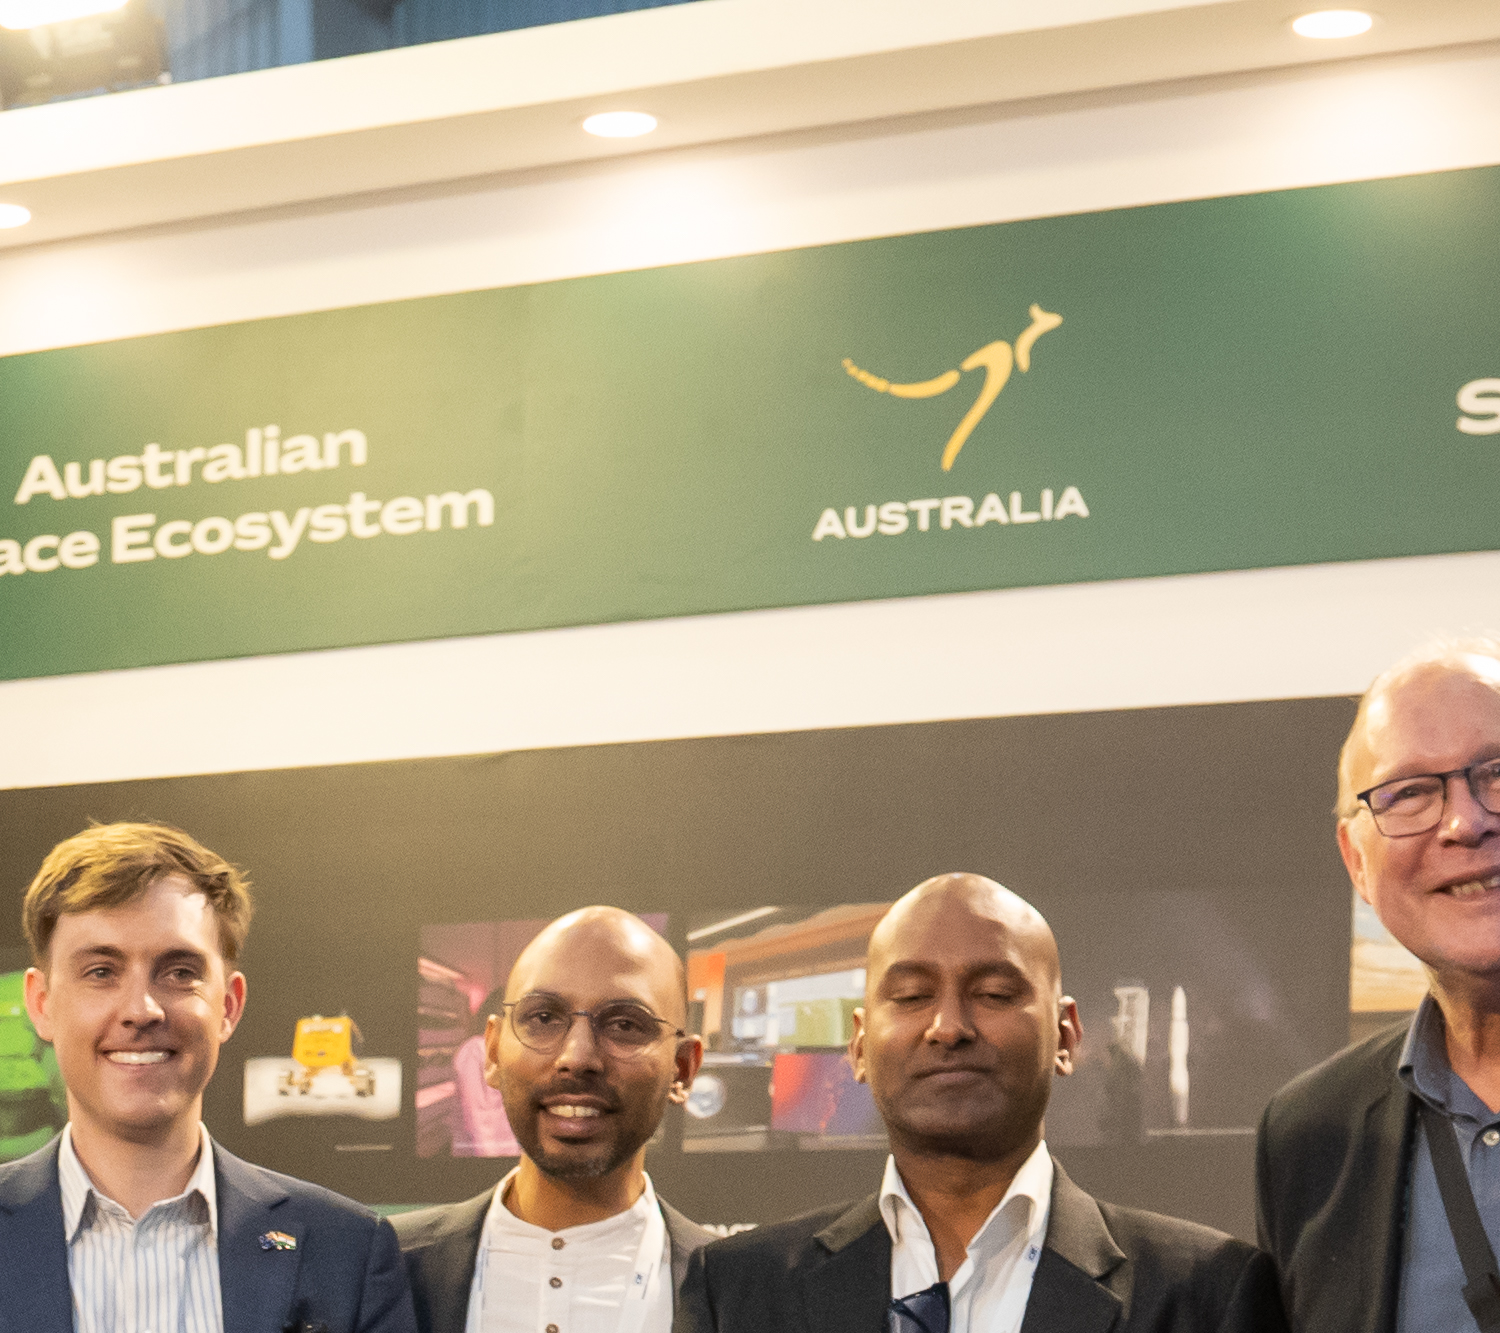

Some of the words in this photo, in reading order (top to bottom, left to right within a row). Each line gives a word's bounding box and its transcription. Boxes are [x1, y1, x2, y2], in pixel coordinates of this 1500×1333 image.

[14, 425, 368, 506] Australian
[111, 486, 495, 567] Ecosystem
[812, 487, 1090, 542] AUSTRALIA
